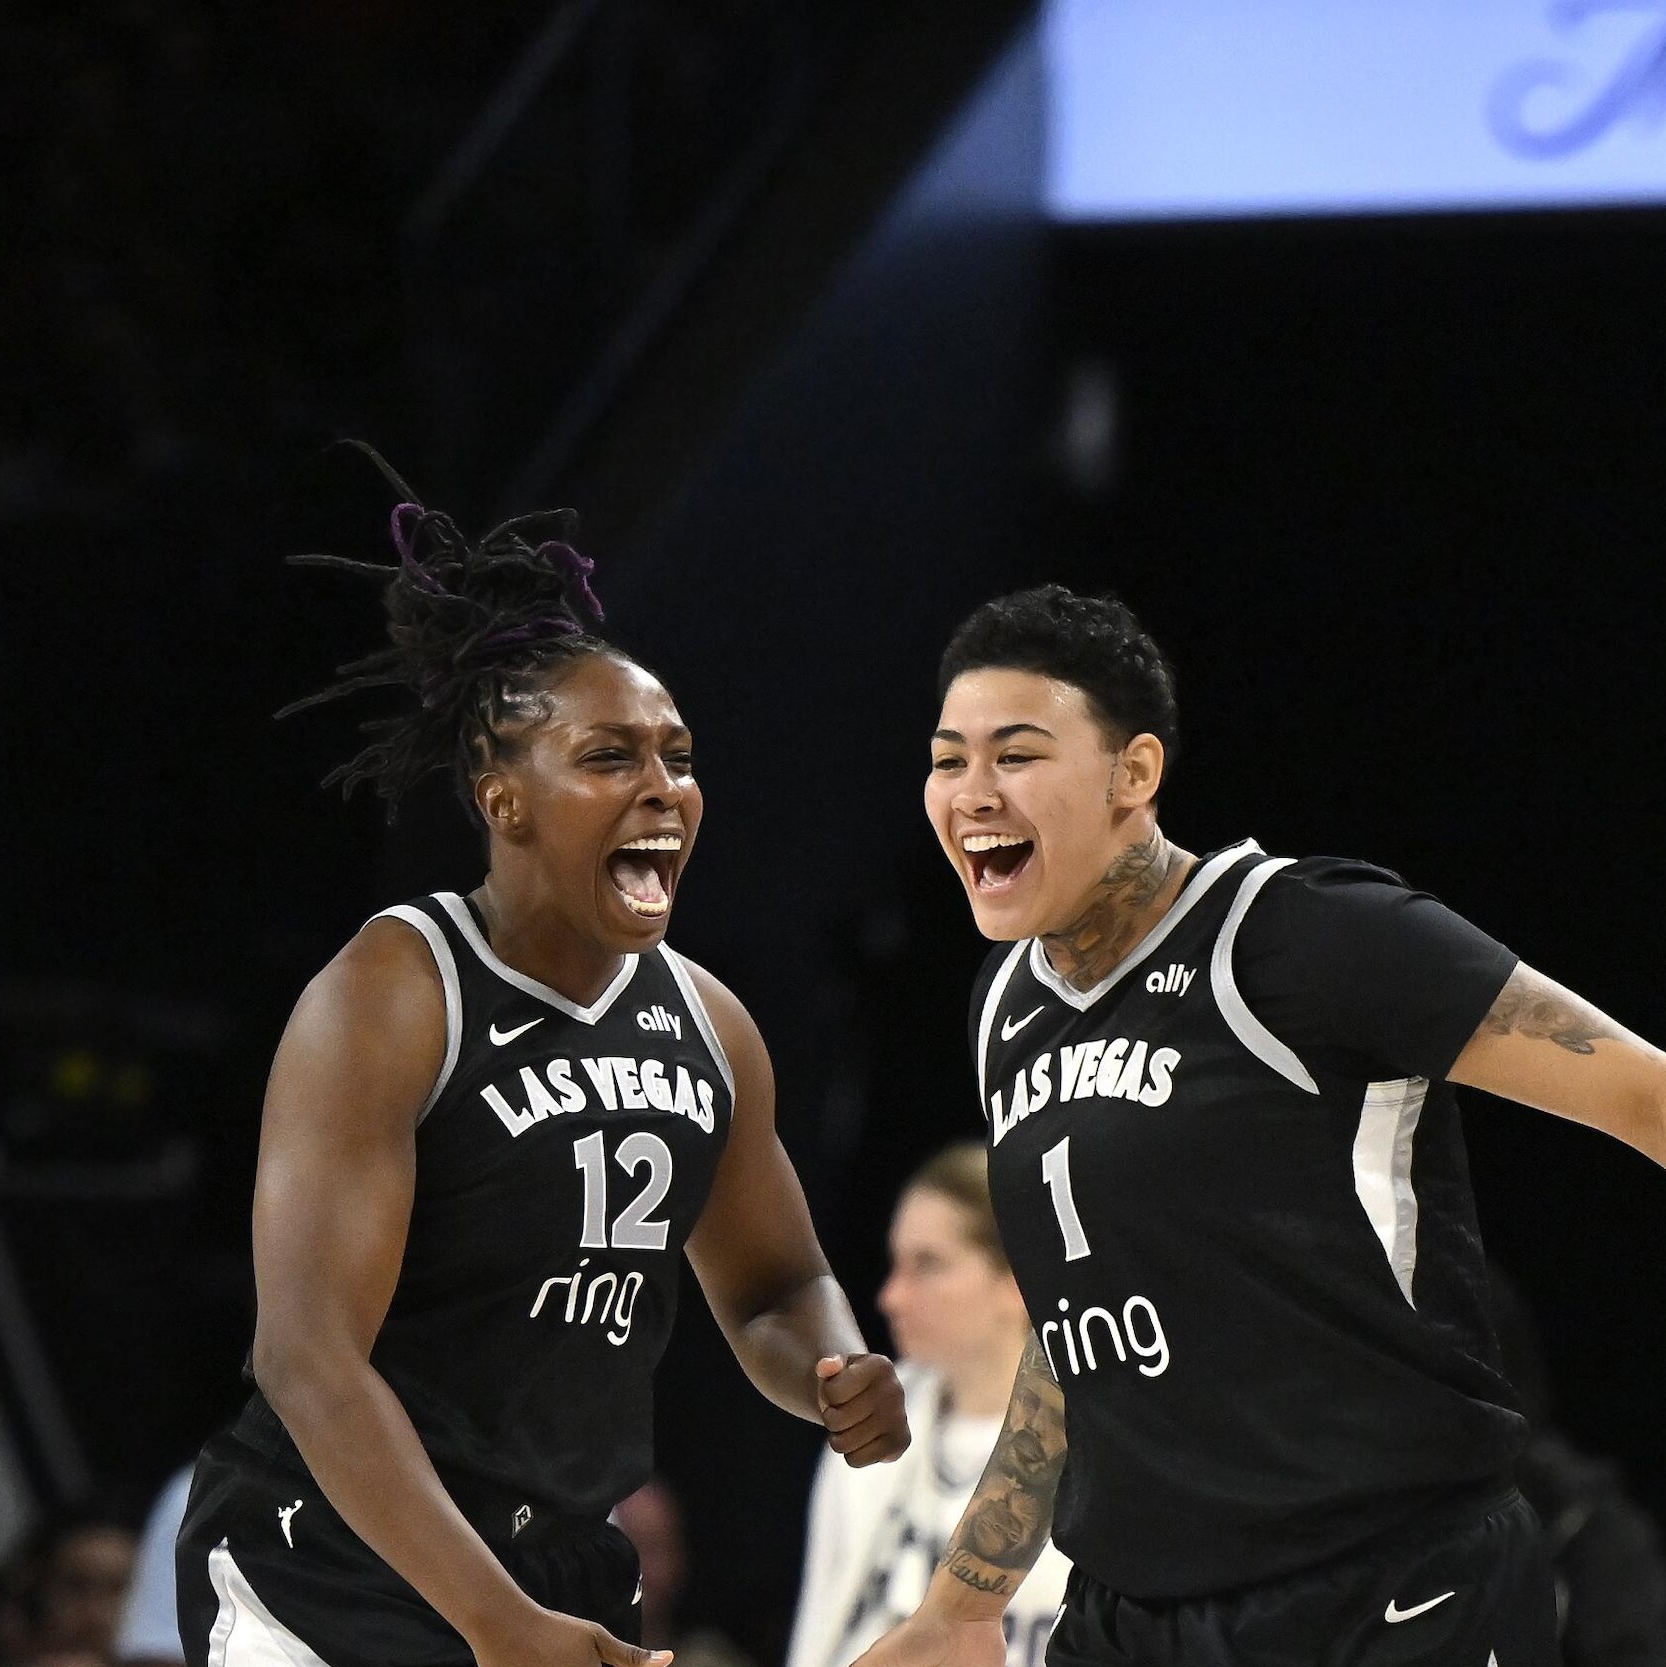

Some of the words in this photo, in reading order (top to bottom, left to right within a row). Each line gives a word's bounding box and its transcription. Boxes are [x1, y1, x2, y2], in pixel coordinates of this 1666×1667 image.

[636, 1005, 682, 1040] ally
[1145, 963, 1197, 997] ally
[480, 1059, 586, 1138] LAS
[580, 1056, 715, 1134] VEGAS
[990, 1053, 1052, 1147] LAS
[1059, 1037, 1182, 1107] VEGAS
[573, 1130, 673, 1250] 12
[1041, 1136, 1091, 1262] 1
[530, 1258, 643, 1346] ring
[1041, 1295, 1170, 1382] ring
